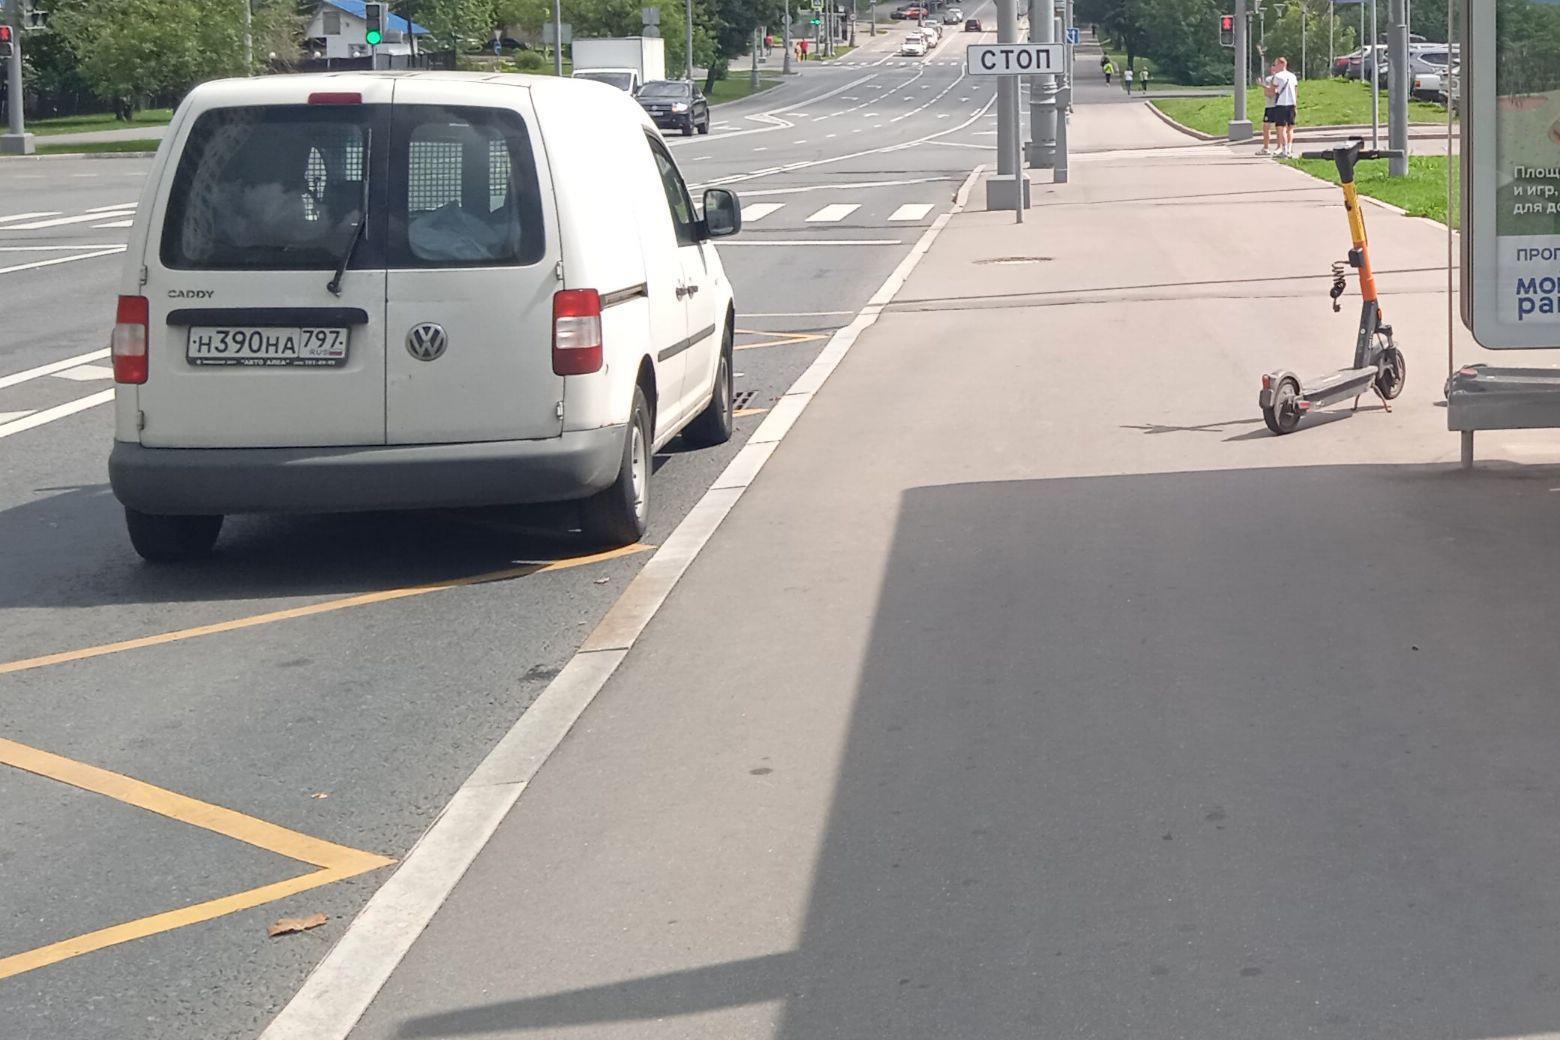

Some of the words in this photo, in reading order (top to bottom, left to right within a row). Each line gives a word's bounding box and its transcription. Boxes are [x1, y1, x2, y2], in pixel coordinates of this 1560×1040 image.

[981, 49, 1051, 70] СТОП
[1513, 186, 1523, 196] и
[1527, 185, 1559, 199] игр,
[1513, 202, 1542, 215] для
[168, 290, 214, 299] CADDY
[302, 330, 340, 348] 797
